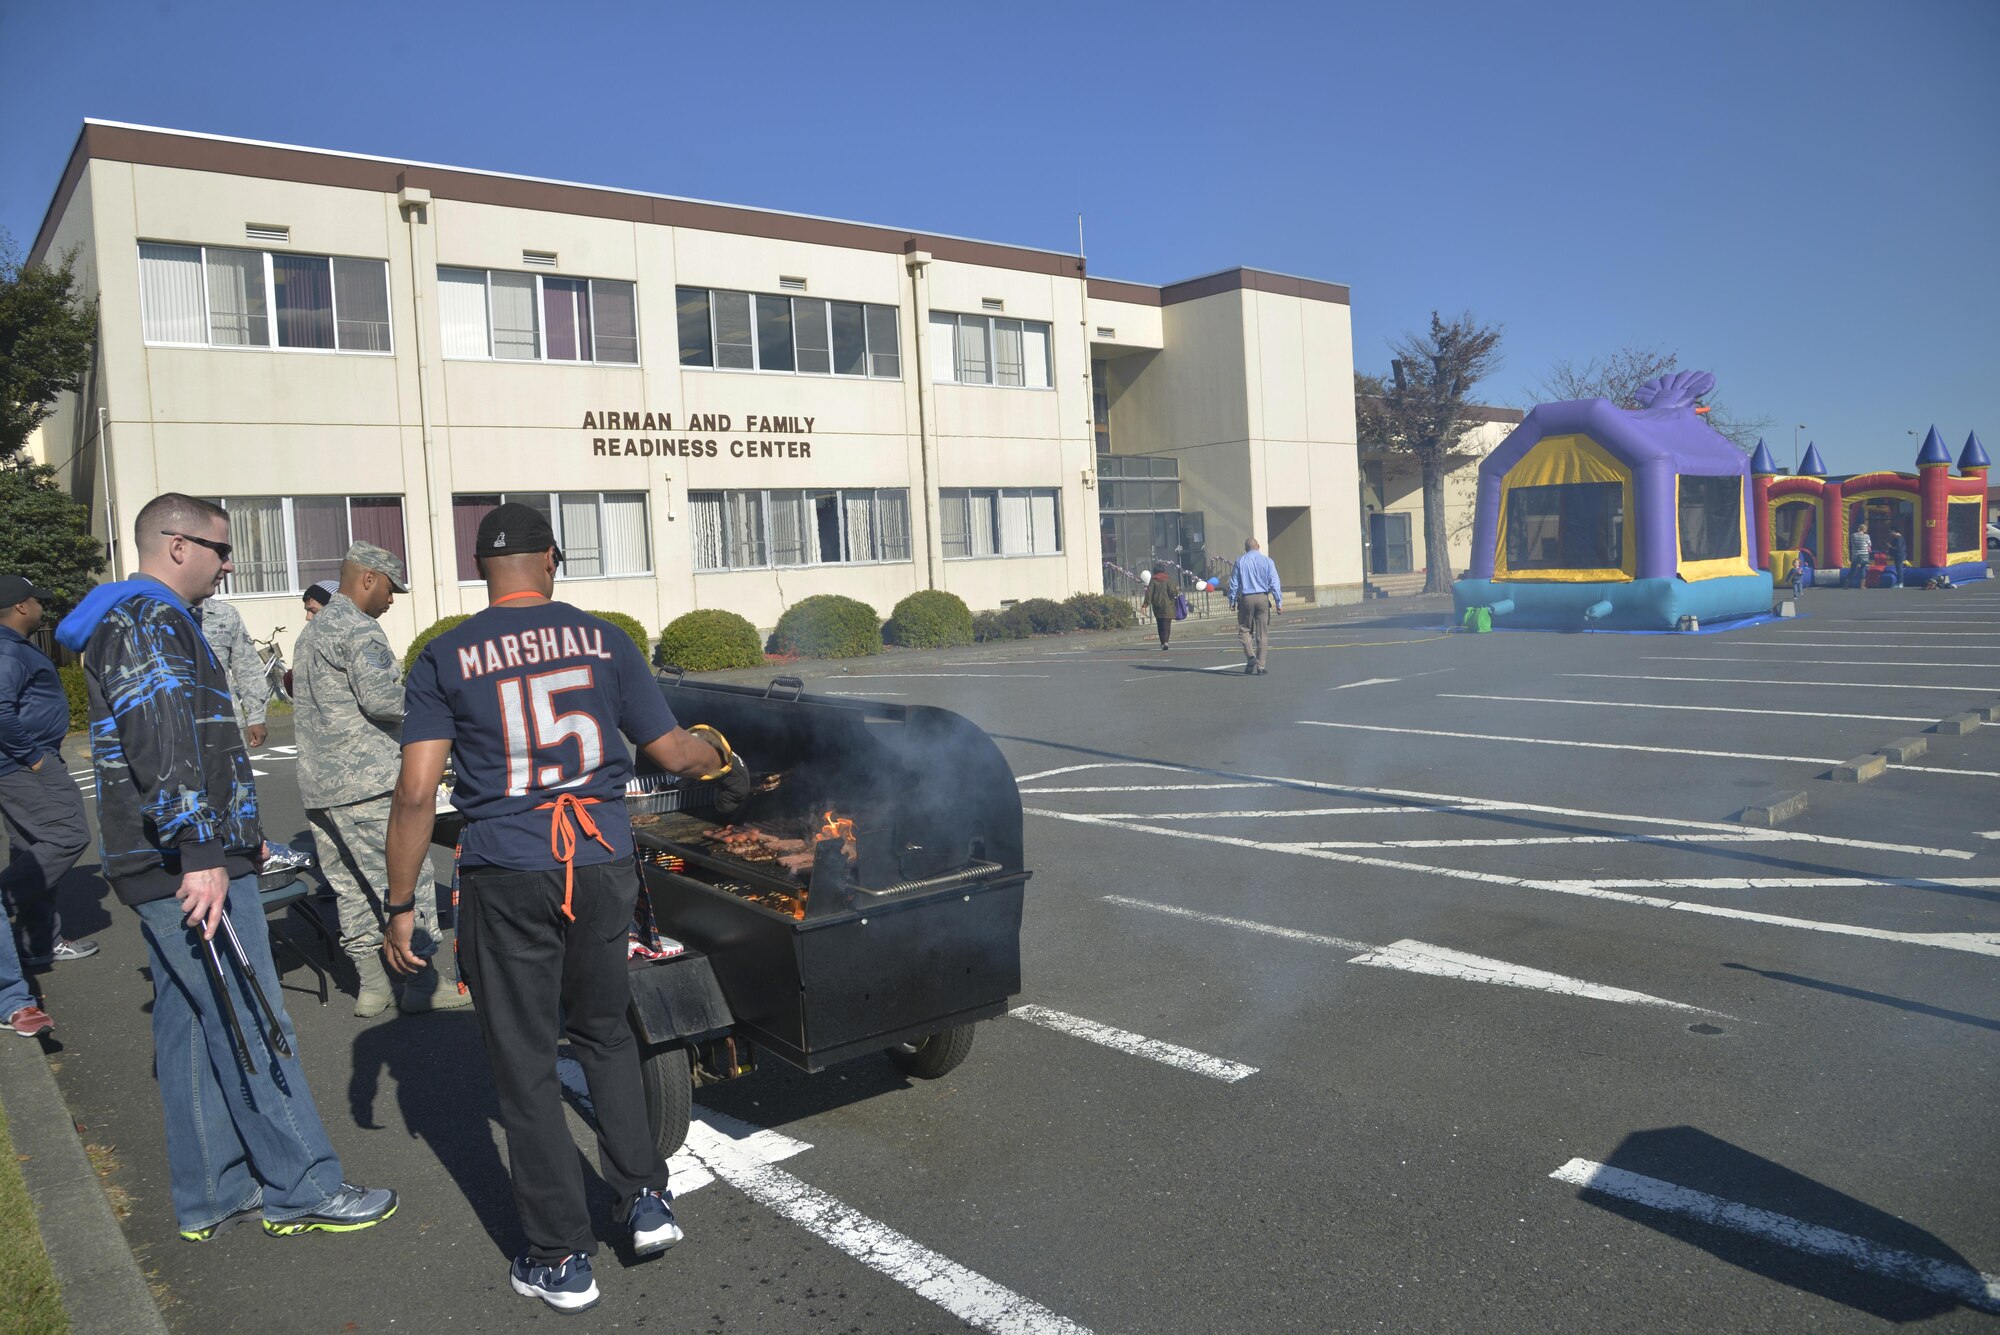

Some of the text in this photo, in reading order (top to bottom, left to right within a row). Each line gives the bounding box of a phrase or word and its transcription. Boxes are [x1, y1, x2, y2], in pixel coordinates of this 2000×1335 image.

[582, 411, 816, 433] AIRMAN AND FAMILY
[593, 438, 811, 458] READINESS CENTER
[457, 626, 612, 680] MARSHALL
[496, 665, 604, 797] 15
